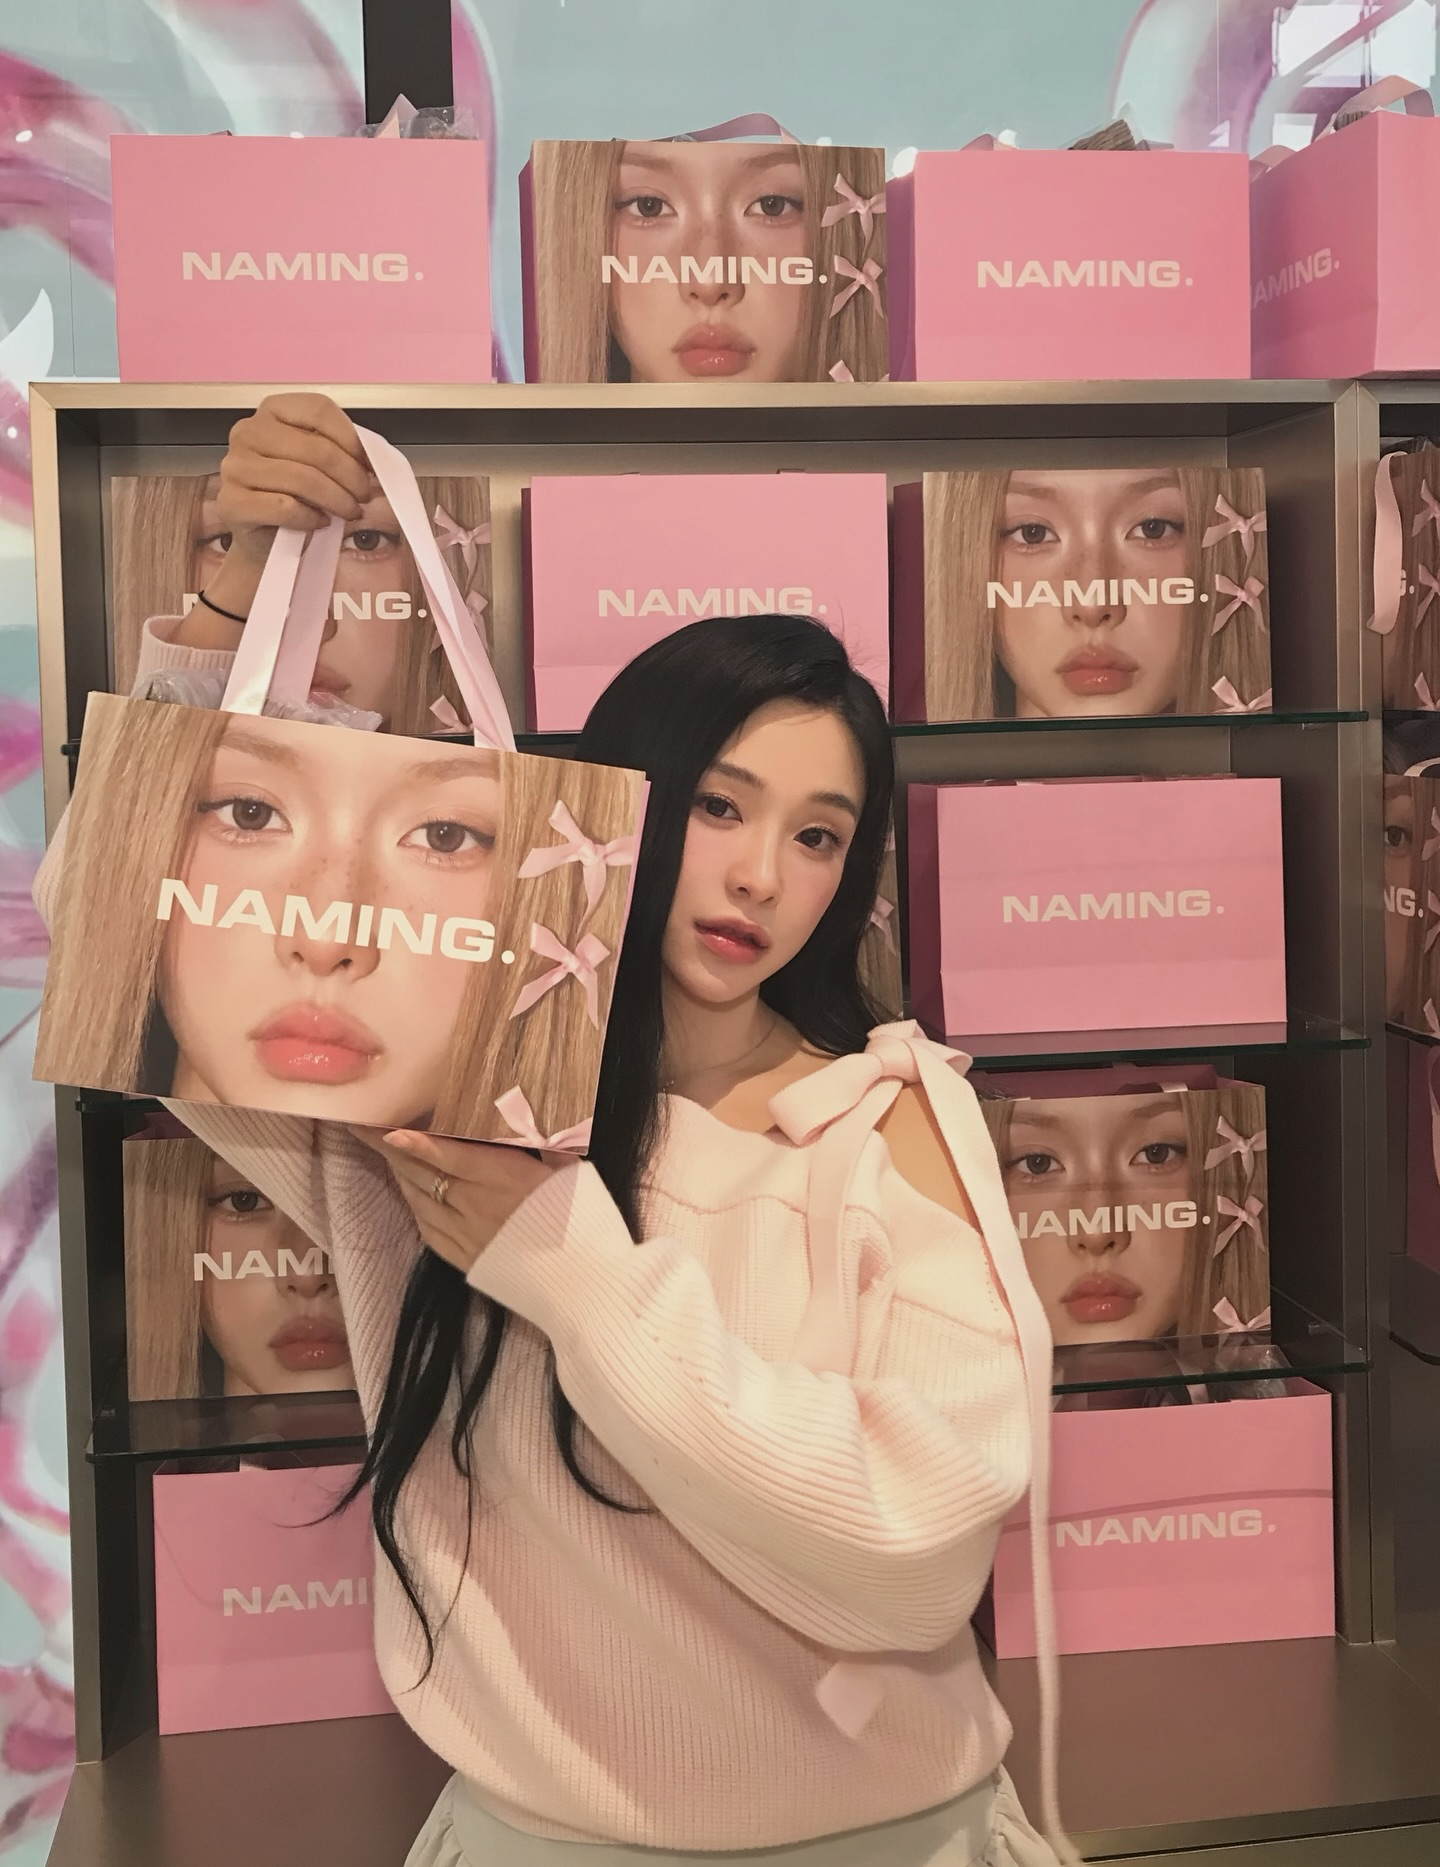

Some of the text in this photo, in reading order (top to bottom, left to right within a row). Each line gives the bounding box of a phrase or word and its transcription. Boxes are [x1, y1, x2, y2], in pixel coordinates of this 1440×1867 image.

[183, 252, 424, 282] NAMING.
[602, 255, 828, 285] NAMING.
[978, 260, 1193, 288] NAMING.
[1250, 247, 1340, 309] AMING.
[598, 586, 828, 617] NAMING.
[987, 577, 1209, 609] NAMING.
[156, 878, 515, 965] NAMING.
[1003, 889, 1225, 923] NAMING.
[1056, 1509, 1276, 1547] NAMING.
[223, 1576, 375, 1617] NAMI
